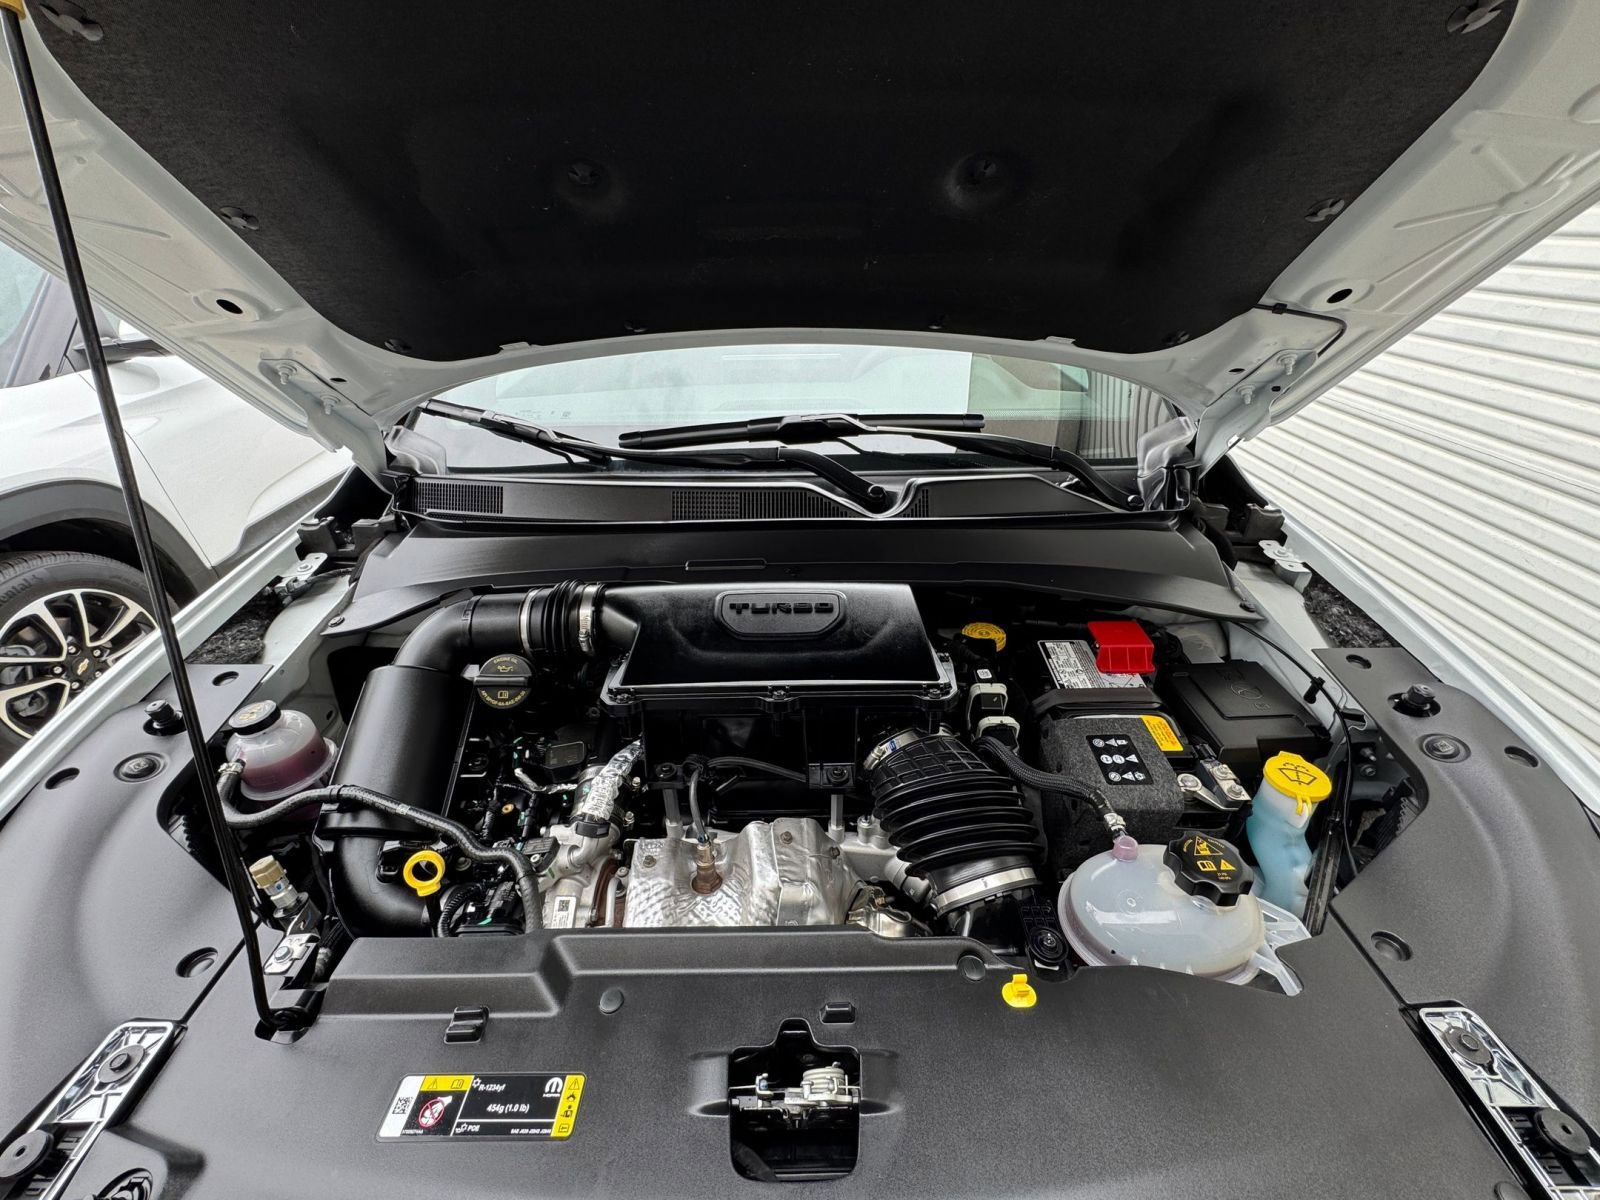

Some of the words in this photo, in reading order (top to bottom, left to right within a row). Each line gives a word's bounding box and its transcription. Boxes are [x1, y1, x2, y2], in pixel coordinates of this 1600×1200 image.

[729, 602, 834, 615] TURBO
[478, 1083, 506, 1092] R-1234yf
[486, 1103, 504, 1114] 454g
[504, 1103, 518, 1114] (1.0
[519, 1103, 530, 1114] lb)
